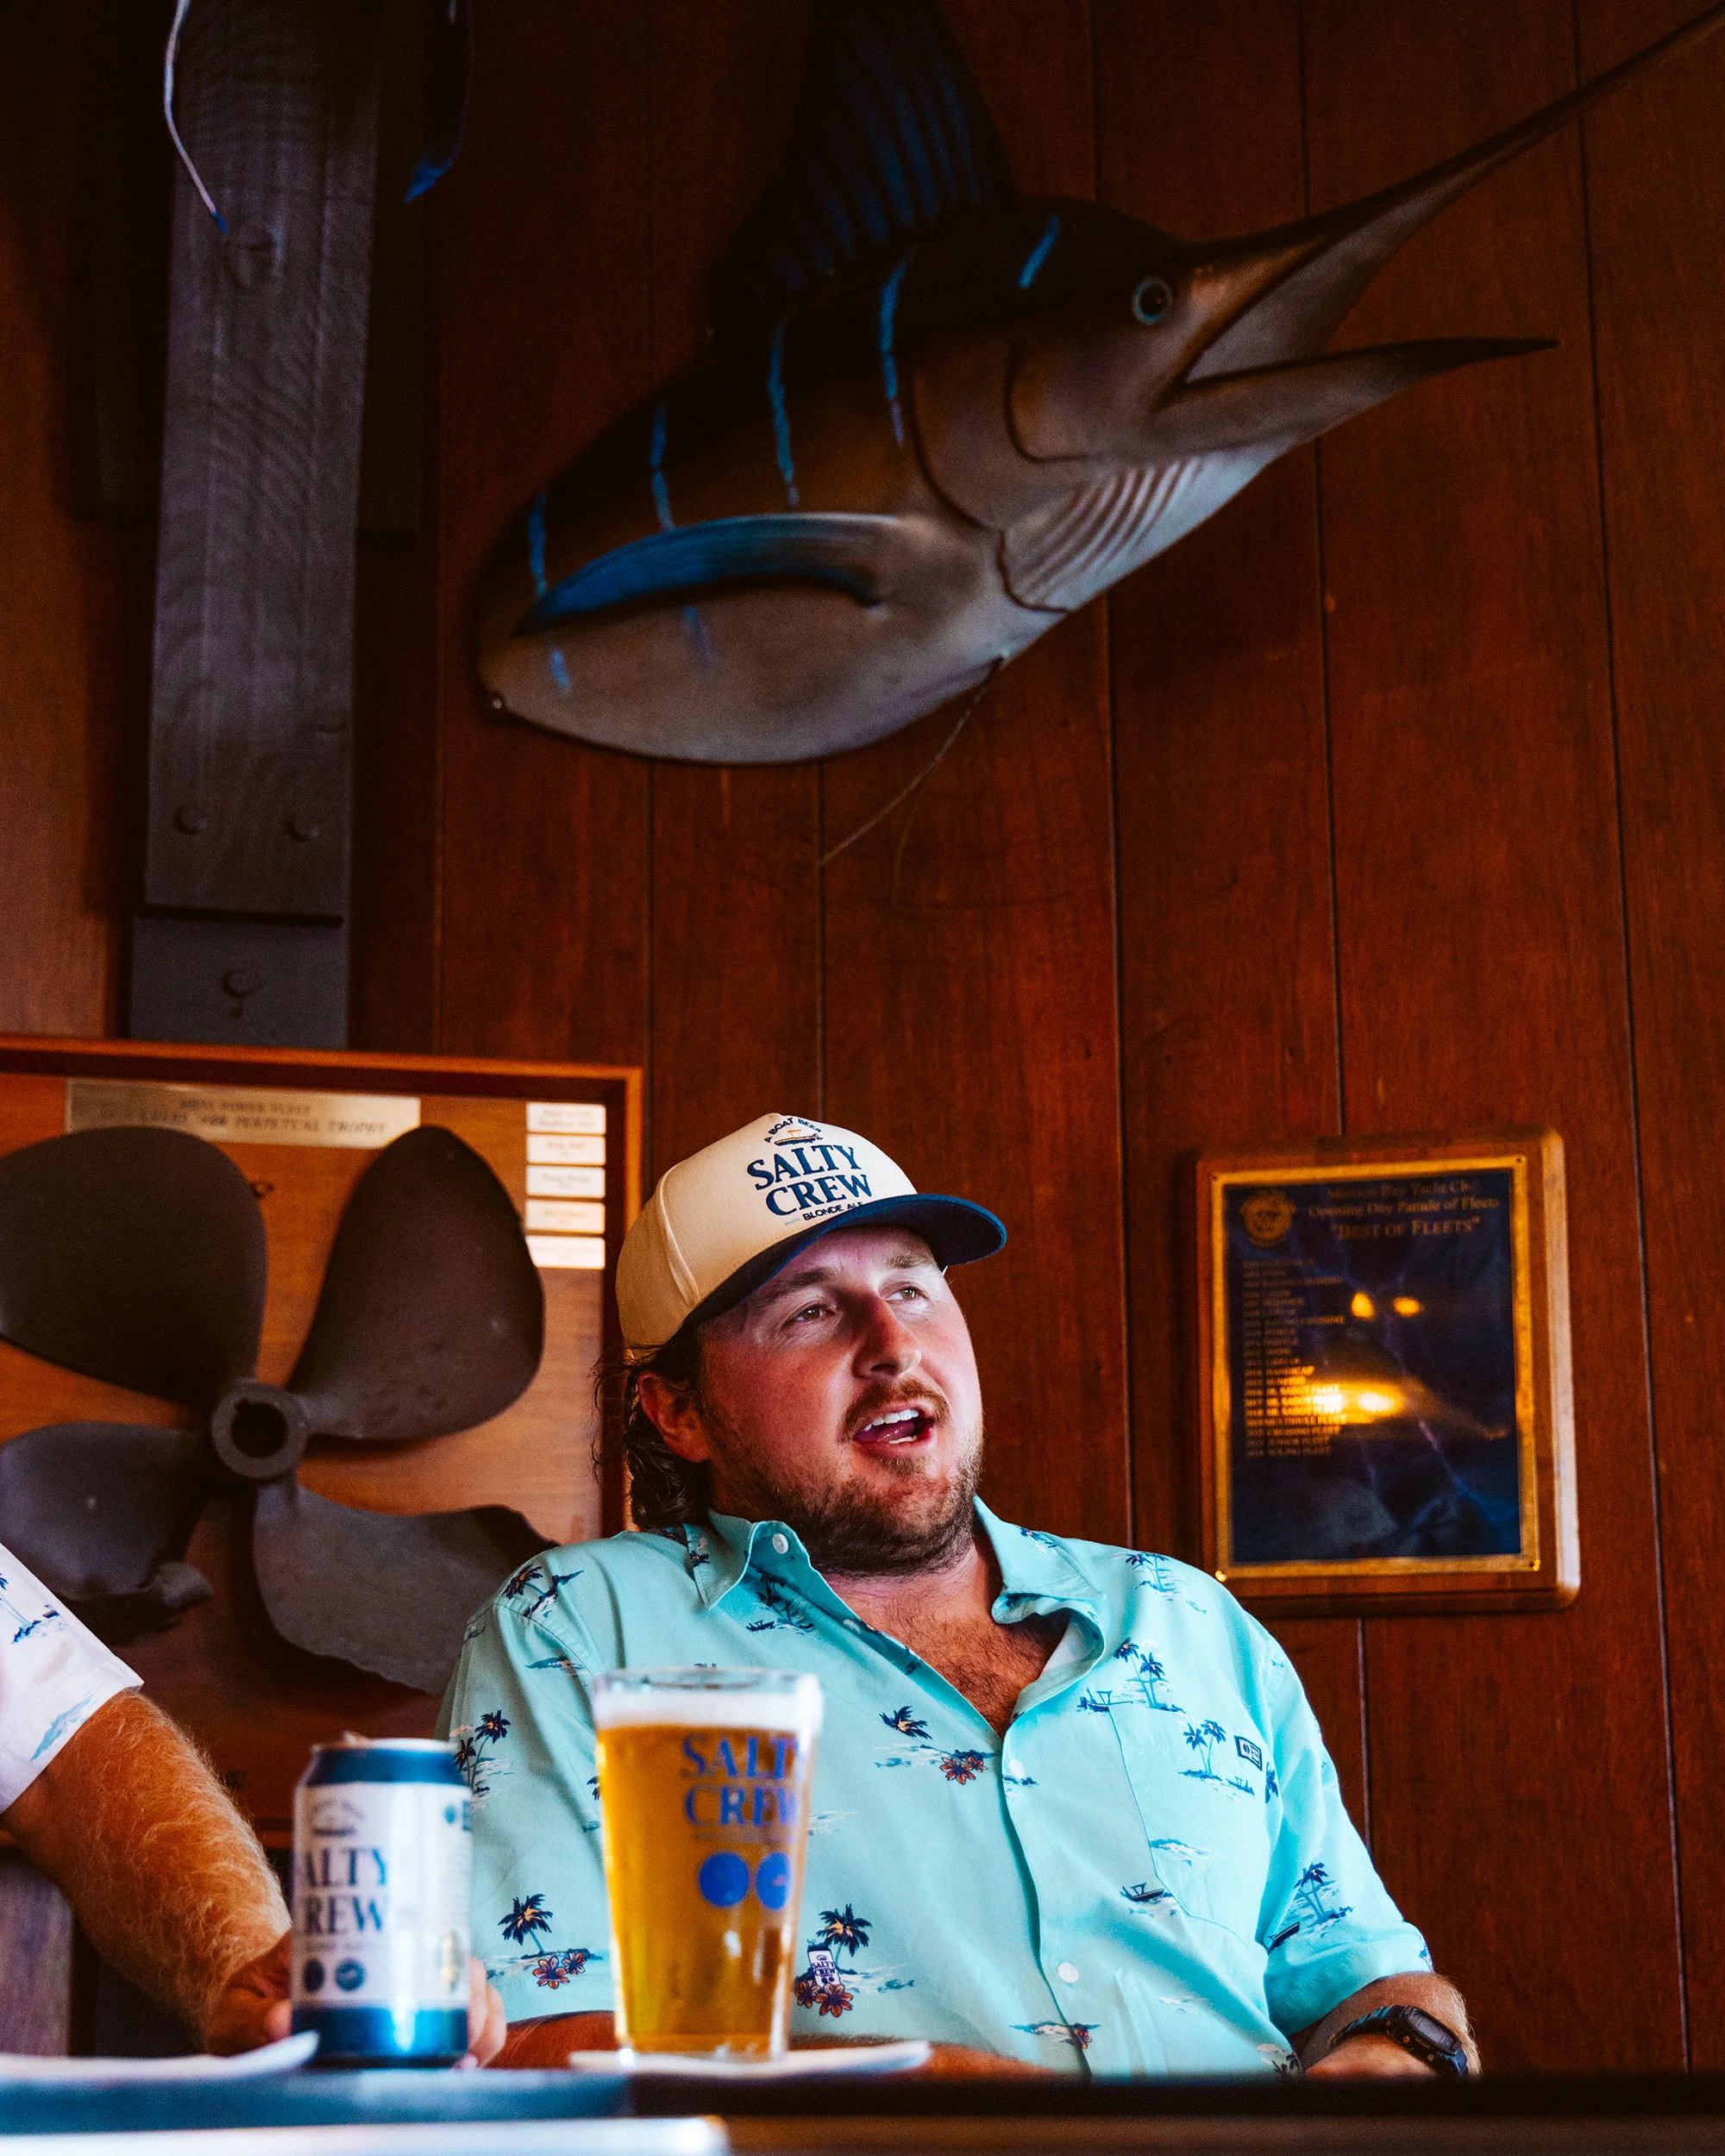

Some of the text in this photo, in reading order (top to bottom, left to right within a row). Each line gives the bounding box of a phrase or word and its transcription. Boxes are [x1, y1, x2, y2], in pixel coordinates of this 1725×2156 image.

[768, 1117, 794, 1135] BOAT
[747, 1144, 862, 1190] SALTY
[766, 1174, 872, 1216] CREW
[802, 1204, 844, 1221] BLONDE
[1308, 1204, 1364, 1219] Opening
[1366, 1201, 1392, 1216] Day
[1397, 1200, 1441, 1213] Parade
[1443, 1195, 1459, 1211] of
[811, 1960, 836, 1969] SALTY
